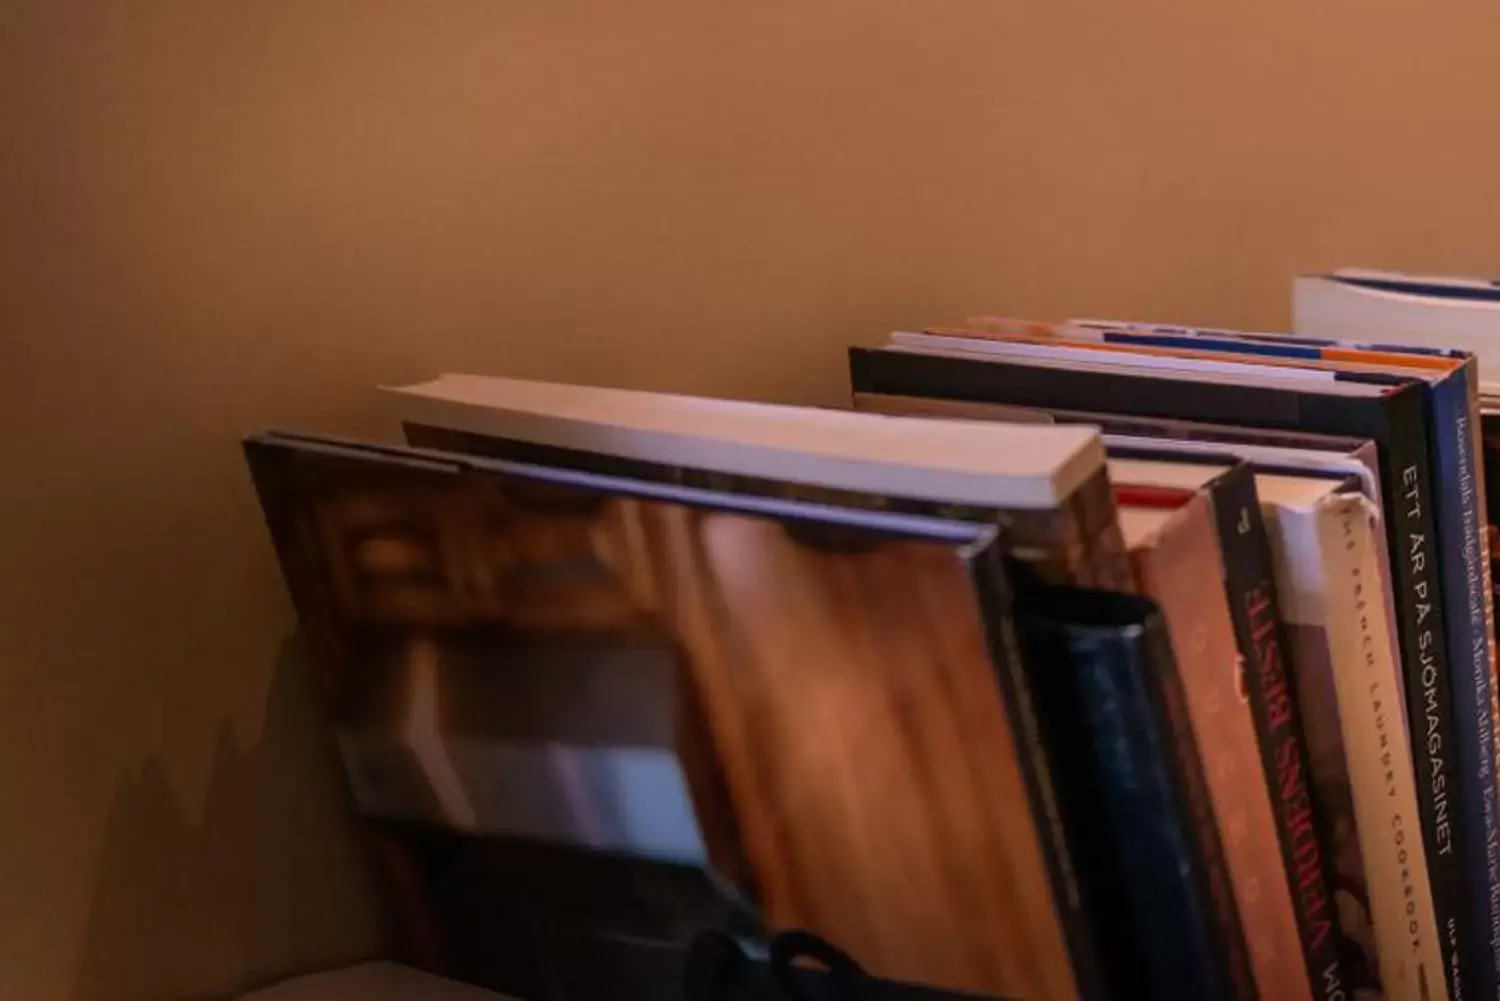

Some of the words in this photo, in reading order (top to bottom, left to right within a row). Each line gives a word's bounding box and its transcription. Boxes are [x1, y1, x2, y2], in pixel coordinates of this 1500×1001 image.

[1402, 465, 1422, 519] ETT
[1408, 532, 1428, 575] ÅR
[1413, 581, 1432, 625] PÅ
[1351, 566, 1376, 667] FRENCH
[1369, 681, 1397, 798] LAUNDRY
[1391, 814, 1421, 954] COOKBOOK
[1418, 630, 1453, 857] SJÖMAGASINET
